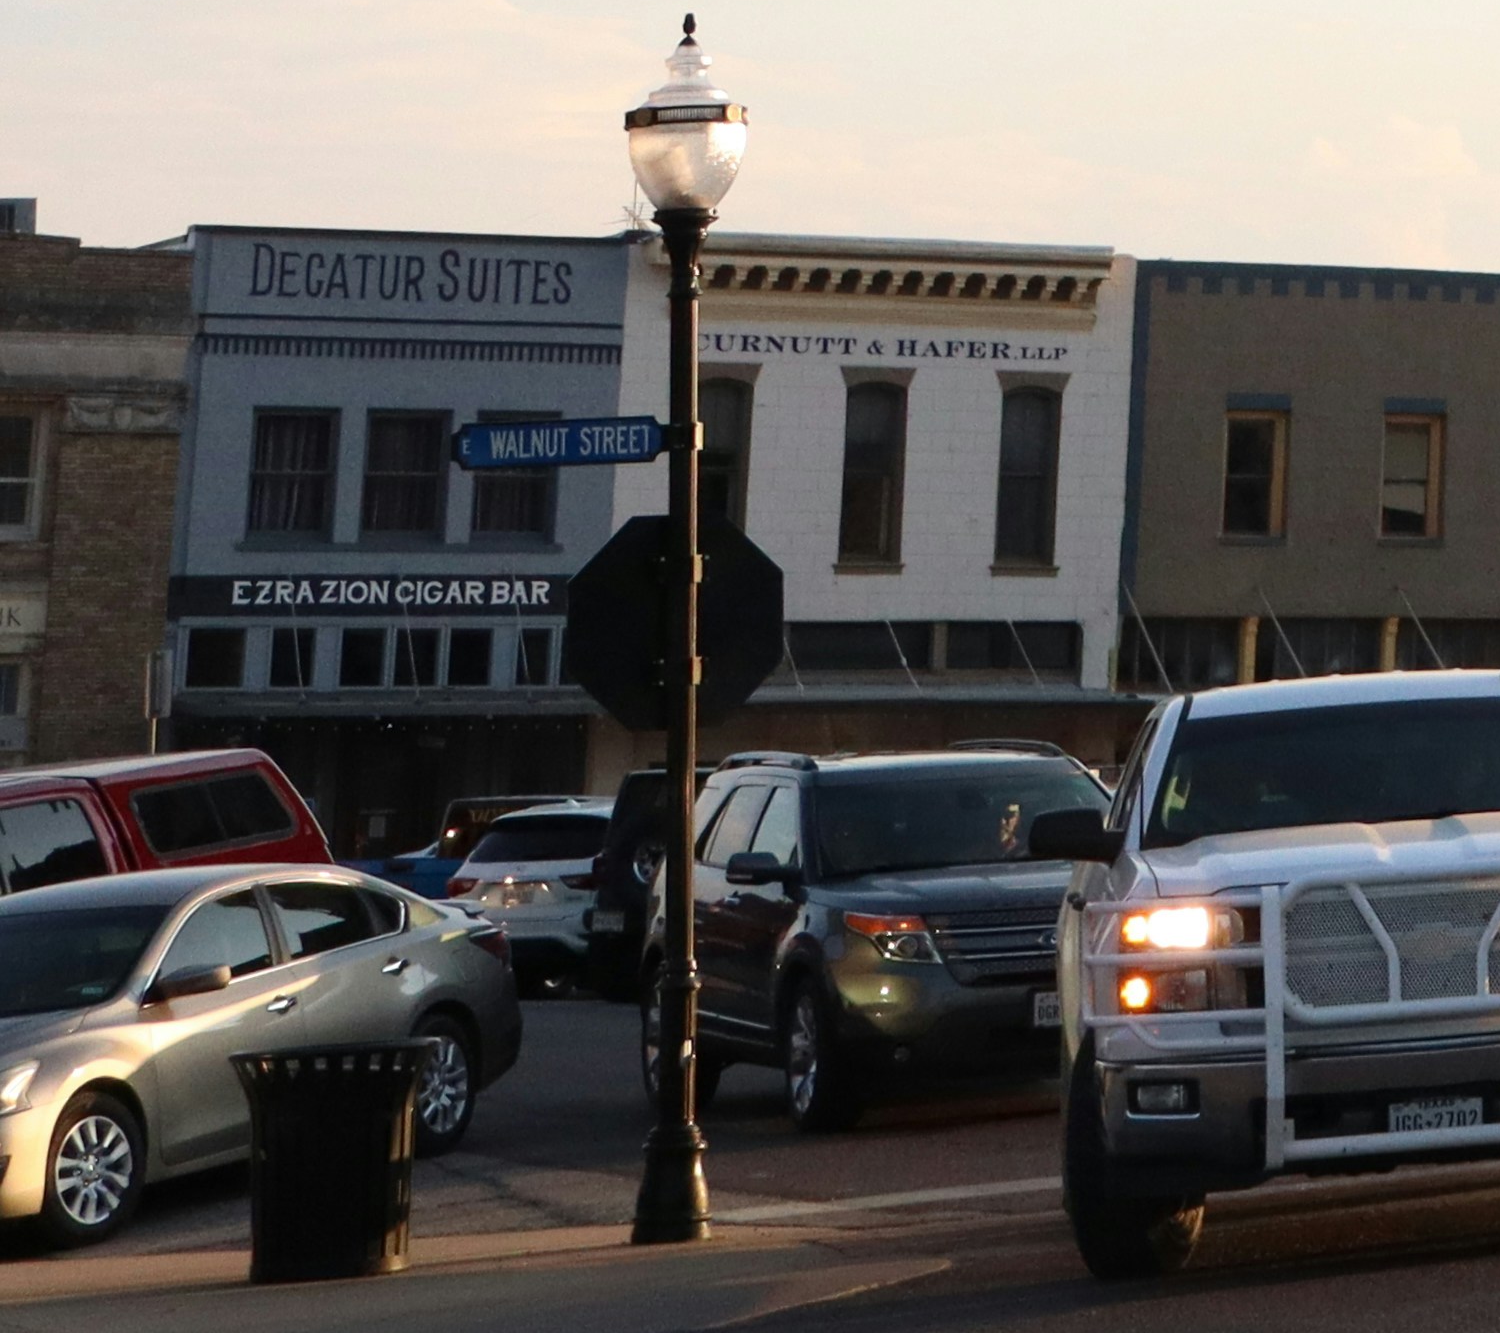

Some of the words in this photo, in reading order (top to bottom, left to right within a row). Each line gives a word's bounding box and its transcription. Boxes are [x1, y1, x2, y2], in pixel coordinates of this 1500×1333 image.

[249, 242, 426, 302] DECATUR
[437, 248, 573, 306] SUITES
[866, 340, 885, 355] &
[462, 439, 471, 455] E
[490, 427, 569, 459] WALNUT
[579, 425, 651, 456] STREET
[231, 580, 315, 606] EZRA
[319, 580, 390, 606] ZION
[394, 580, 485, 606] CIGAR
[490, 580, 551, 606] BAR
